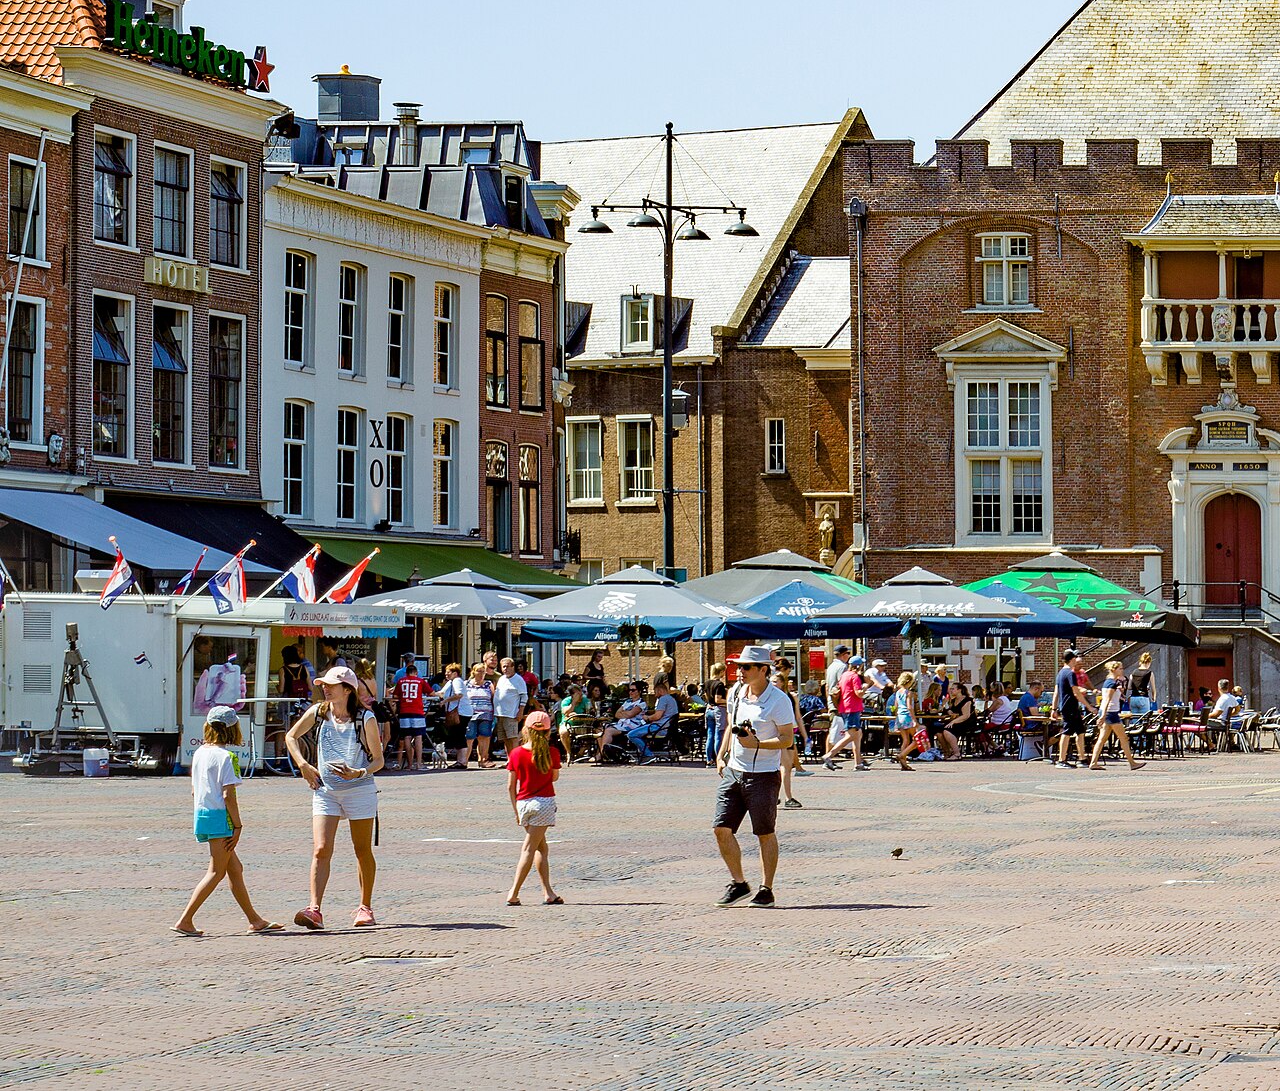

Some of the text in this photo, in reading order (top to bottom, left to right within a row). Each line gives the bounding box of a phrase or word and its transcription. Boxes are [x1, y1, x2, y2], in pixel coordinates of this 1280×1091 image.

[152, 258, 213, 295] HOTEL
[1037, 594, 1160, 612] eken
[401, 683, 419, 699] 99
